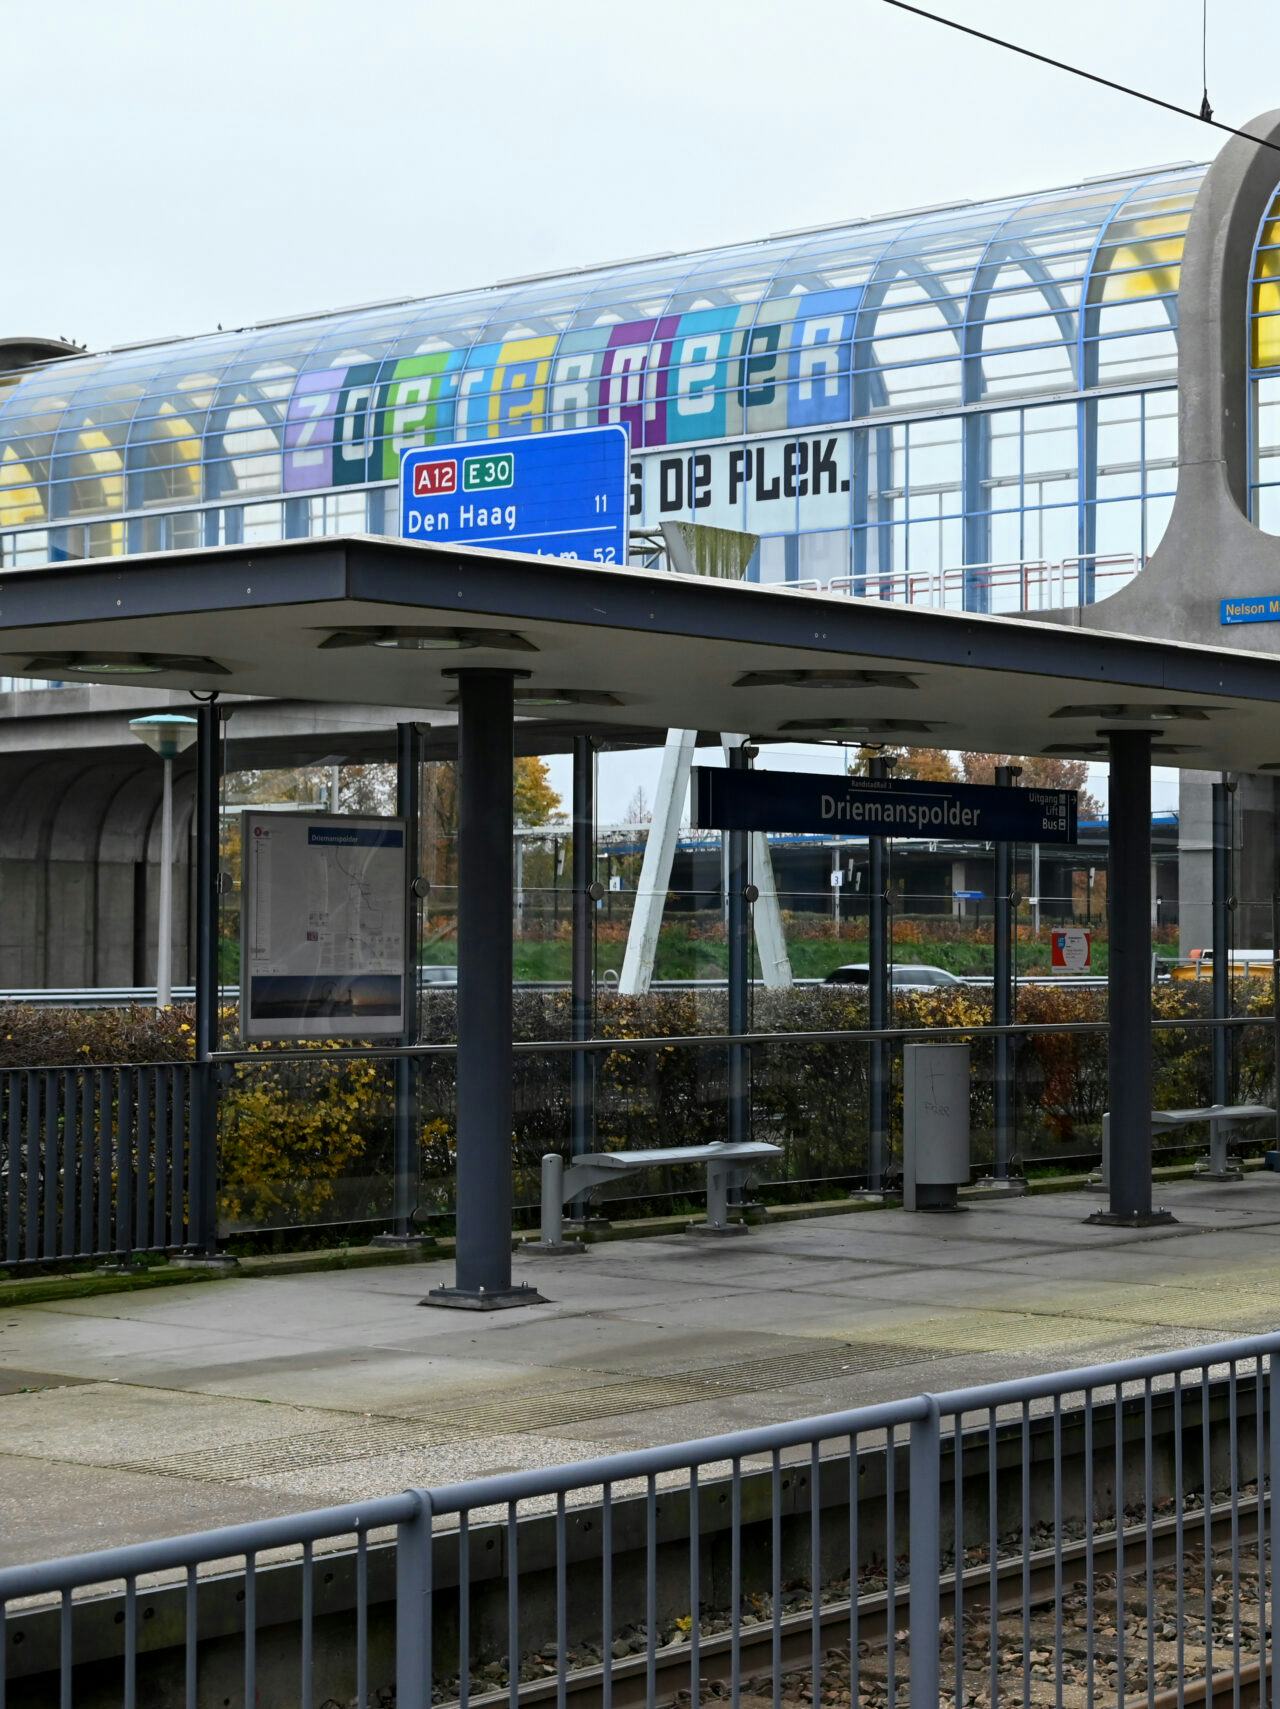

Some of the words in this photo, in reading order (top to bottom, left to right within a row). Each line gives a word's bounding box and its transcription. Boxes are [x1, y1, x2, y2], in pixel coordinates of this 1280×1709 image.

[417, 466, 453, 491] A12
[408, 509, 449, 534] Den
[459, 503, 517, 531] Haag
[594, 494, 607, 513] 11
[593, 546, 616, 565] 52
[1226, 603, 1265, 616] Nelson
[1028, 792, 1058, 806] Uitgang
[821, 794, 981, 830] Driemanspolder
[1045, 805, 1059, 816] Lift
[1042, 818, 1058, 830] Bus
[834, 875, 840, 886] 3
